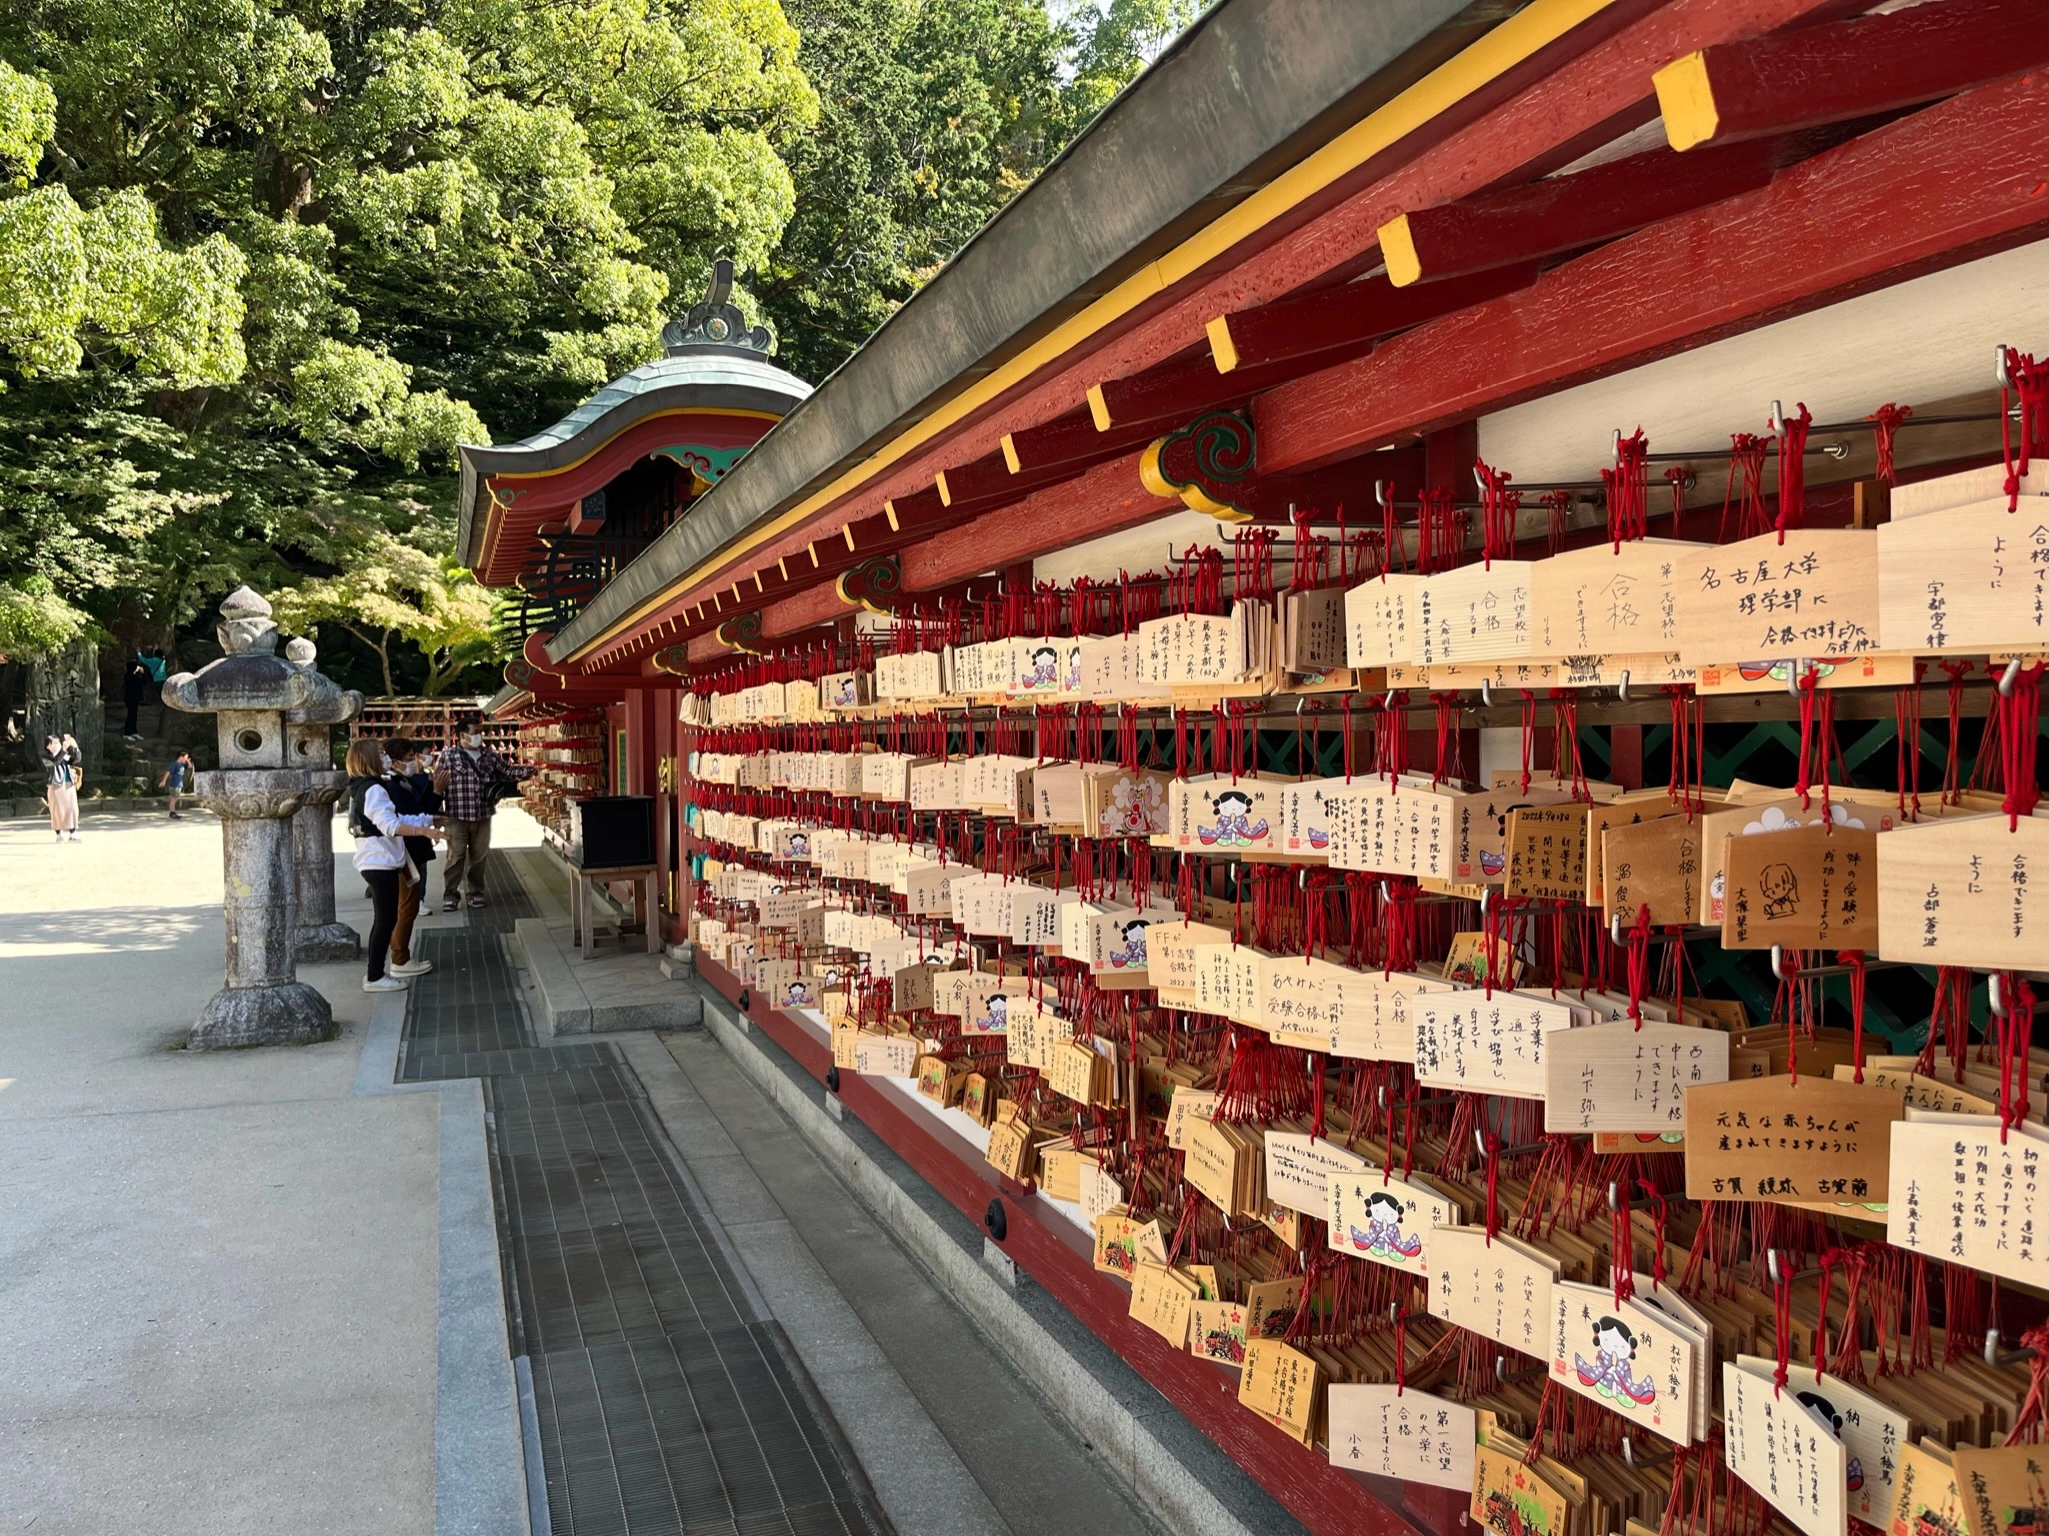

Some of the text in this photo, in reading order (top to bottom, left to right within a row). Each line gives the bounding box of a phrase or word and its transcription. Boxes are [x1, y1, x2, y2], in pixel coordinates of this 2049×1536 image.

[1700, 552, 1819, 591] 名古屋大学
[1991, 536, 2005, 588] ように
[1480, 591, 1500, 630] 合格
[1600, 574, 1640, 630] 合格
[1739, 589, 1827, 615] 理学部に
[1761, 620, 1866, 648] 合格できますように
[1203, 790, 1265, 802] 奉 納
[1290, 791, 1300, 836] 太宰府天満宮
[1314, 789, 1323, 802] 奉
[1486, 803, 1497, 819] 奉
[1460, 807, 1470, 862] 太宰府天満宮
[940, 877, 951, 901] 合格
[1678, 838, 1696, 920] 合格します
[1820, 849, 1836, 940] 成功しますように
[1842, 852, 1861, 925] 妹の受験が
[1969, 855, 1982, 894] ように
[2010, 854, 2028, 938] 合格できます
[1113, 920, 1120, 931] 奉
[979, 993, 985, 1002] 奉
[1373, 983, 1382, 1050] しますように
[1391, 991, 1407, 1023] 合格
[1471, 1008, 1480, 1048] 自己を
[1530, 1011, 1544, 1064] 学業を
[1635, 1045, 1643, 1101] ように
[1651, 1045, 1664, 1113] できます
[1668, 1043, 1682, 1121] 中に合格
[1690, 1045, 1703, 1080] 西南
[1716, 1112, 1860, 1133] 元気な赤ちゃんが
[1718, 1134, 1857, 1153] 産まれてきますように
[1334, 1183, 1343, 1232] 太宰府天満宮
[1355, 1185, 1417, 1212] 奉 納
[1712, 1177, 1743, 1194] 古賀
[1494, 1268, 1505, 1338] 合格できます
[1524, 1275, 1533, 1344] 志望大学に
[1557, 1297, 1567, 1358] 太宰府天満宮
[1580, 1304, 1652, 1348] 奉 納
[1668, 1343, 1681, 1400] ねがい絵馬
[1380, 1404, 1395, 1475] できますように。
[1398, 1406, 1413, 1436] 合格
[1419, 1413, 1432, 1463] の大学に
[1846, 1407, 1860, 1428] 納
[1349, 1434, 1364, 1459] 小春
[1437, 1410, 1452, 1472] 第一志望
[1879, 1421, 1896, 1486] ねがい絵馬
[1505, 1465, 1512, 1477] 奉
